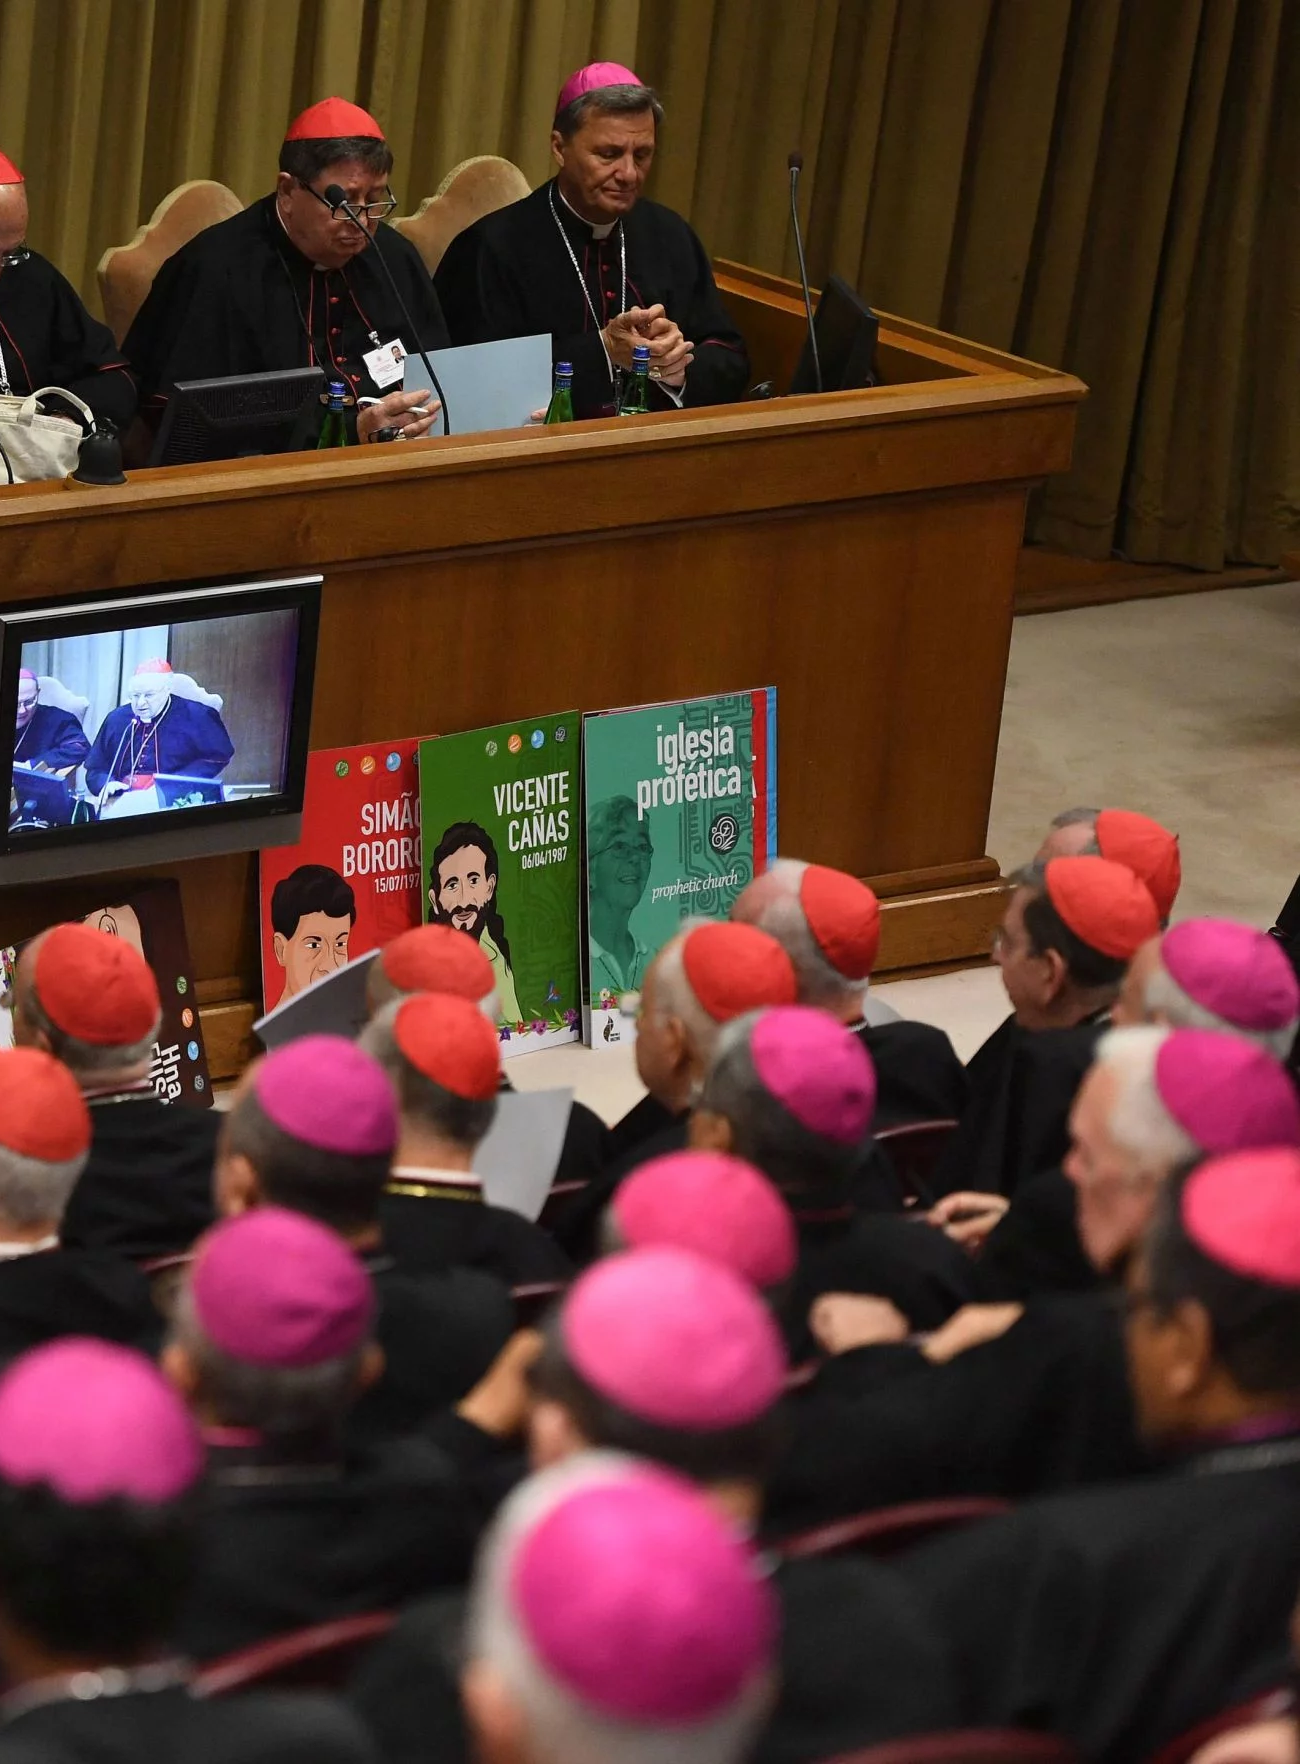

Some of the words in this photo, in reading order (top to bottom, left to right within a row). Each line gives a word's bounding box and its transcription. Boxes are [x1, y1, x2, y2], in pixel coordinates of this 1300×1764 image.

[656, 715, 735, 775] iglesia
[493, 770, 570, 817] VICENTE
[637, 758, 742, 822] profética
[508, 808, 570, 852] CAÑAS
[521, 846, 568, 870] 06/04/1987
[651, 877, 703, 904] prophetic
[702, 869, 739, 891] church
